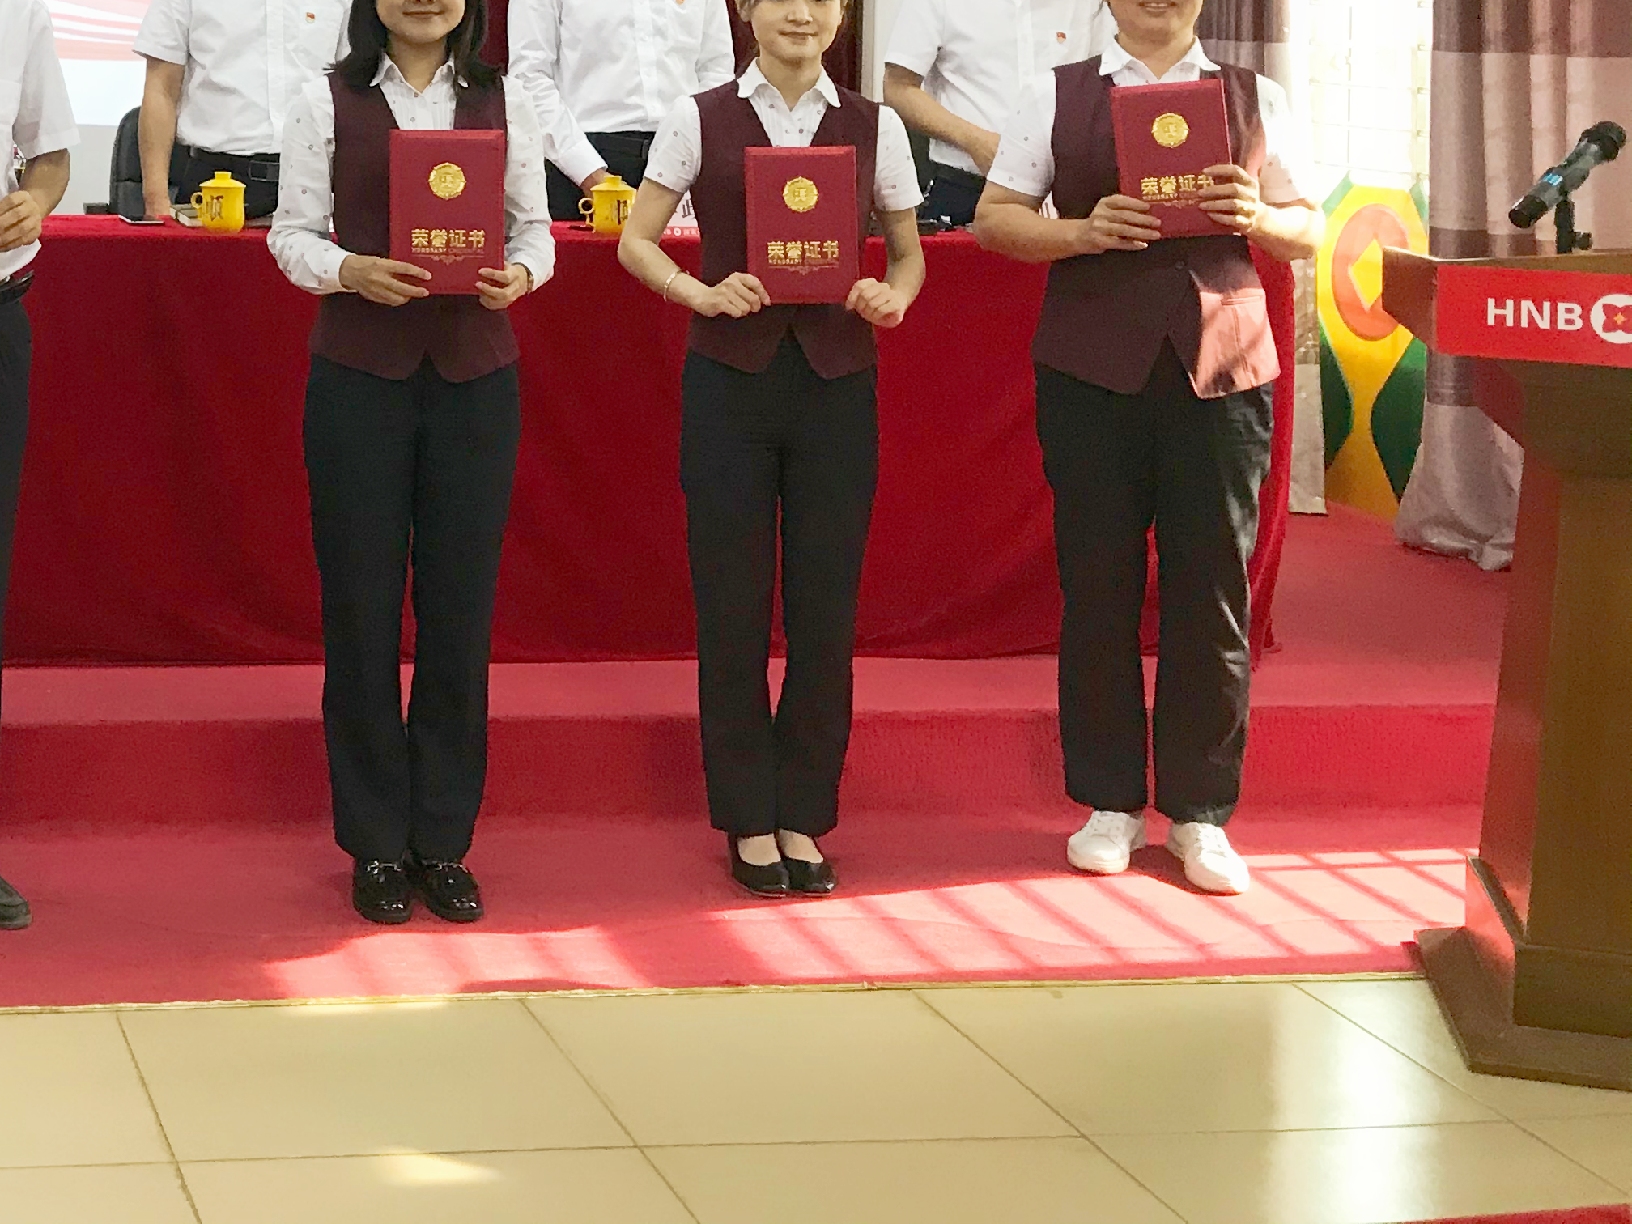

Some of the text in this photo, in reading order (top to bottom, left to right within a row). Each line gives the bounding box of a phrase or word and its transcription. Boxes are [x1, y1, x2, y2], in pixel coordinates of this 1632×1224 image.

[410, 228, 486, 248] 荣誉证书
[767, 240, 839, 259] 荣誉证书
[1487, 298, 1584, 331] HNB
